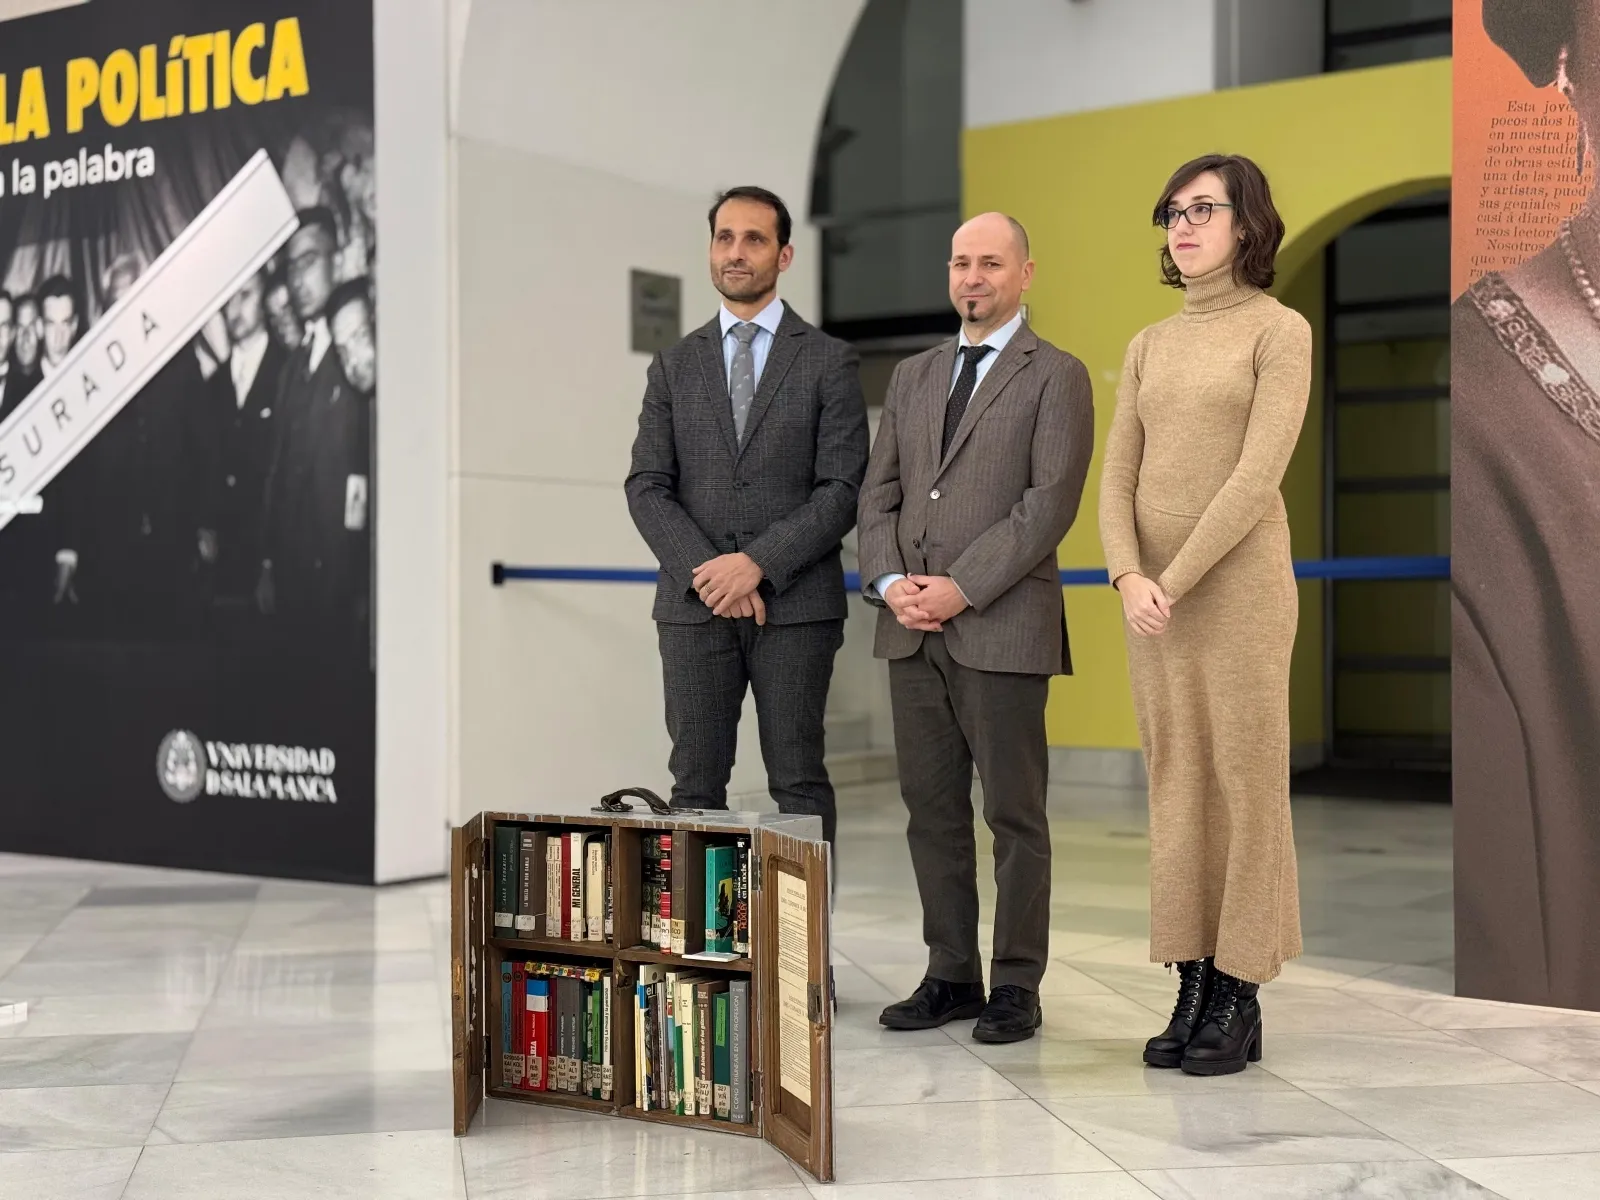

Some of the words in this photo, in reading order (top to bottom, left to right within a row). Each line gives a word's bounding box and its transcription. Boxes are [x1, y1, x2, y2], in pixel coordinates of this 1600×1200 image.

[1507, 101, 1535, 112] Esta
[1491, 117, 1527, 128] pocos
[1532, 116, 1562, 126] años
[1489, 131, 1504, 140] en
[1510, 130, 1560, 140] nuestra
[1487, 142, 1523, 153] sobre
[1485, 156, 1501, 167] de
[1505, 156, 1542, 168] obras
[12, 159, 36, 195] la
[43, 143, 155, 199] palabra
[1483, 172, 1507, 181] una
[1512, 170, 1528, 181] de
[1533, 170, 1552, 181] las
[1480, 186, 1489, 197] y
[1494, 184, 1548, 198] artistas,
[1479, 200, 1500, 209] sus
[1503, 198, 1561, 211] geniales
[1477, 212, 1502, 222] casi
[1518, 212, 1560, 224] diario
[1475, 227, 1510, 236] rosos
[1487, 239, 1546, 251] Nosotros
[1471, 255, 1496, 266] que
[572, 868, 581, 898] GENERAL
[572, 899, 581, 908] MI
[734, 1032, 740, 1042] SU
[734, 1043, 740, 1053] EN
